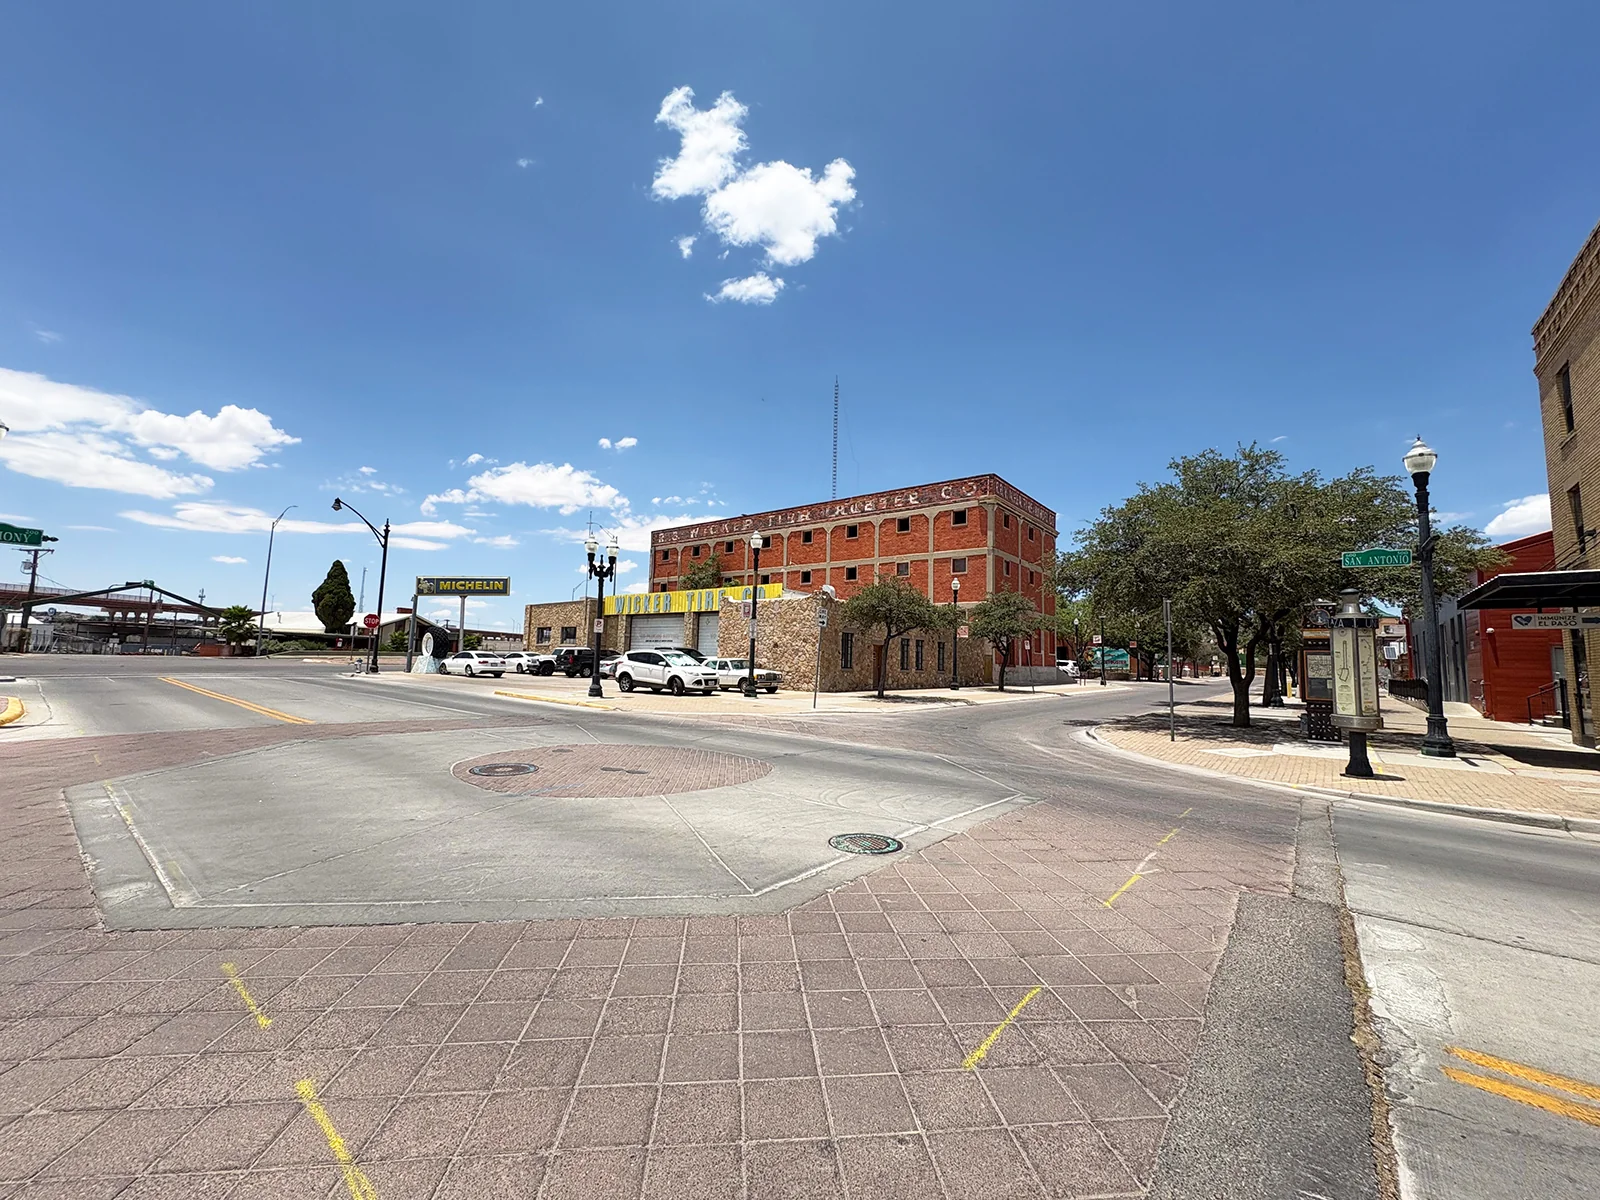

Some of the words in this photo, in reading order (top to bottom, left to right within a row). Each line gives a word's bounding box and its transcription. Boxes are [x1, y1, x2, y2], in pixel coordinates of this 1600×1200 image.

[1344, 556, 1362, 566] SAN
[1367, 555, 1409, 565] ANTONIO
[439, 581, 504, 590] MICHELIN
[615, 593, 672, 613] WICKER
[364, 617, 380, 625] STOP
